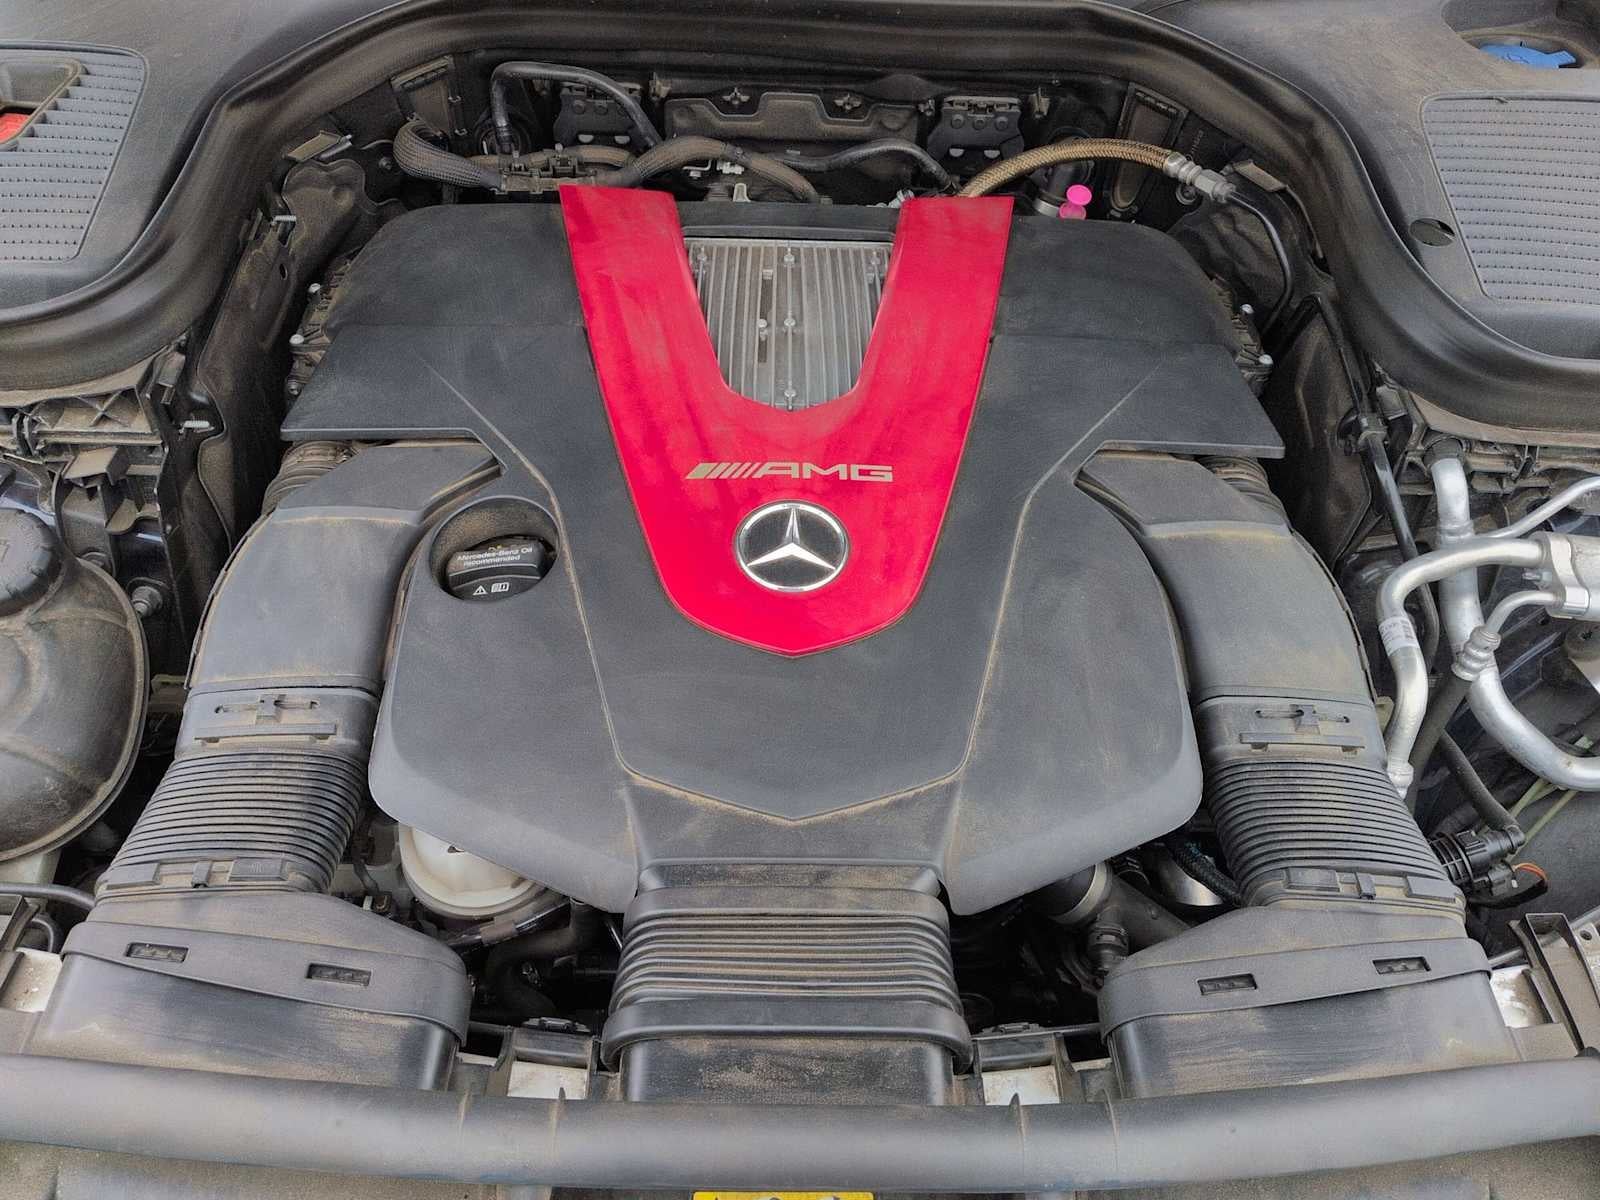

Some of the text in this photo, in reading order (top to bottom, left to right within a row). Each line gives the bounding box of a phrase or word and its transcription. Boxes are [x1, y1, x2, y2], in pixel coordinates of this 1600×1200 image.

[751, 462, 893, 482] AMG
[457, 546, 533, 560] Mercedes-Benz Oil
